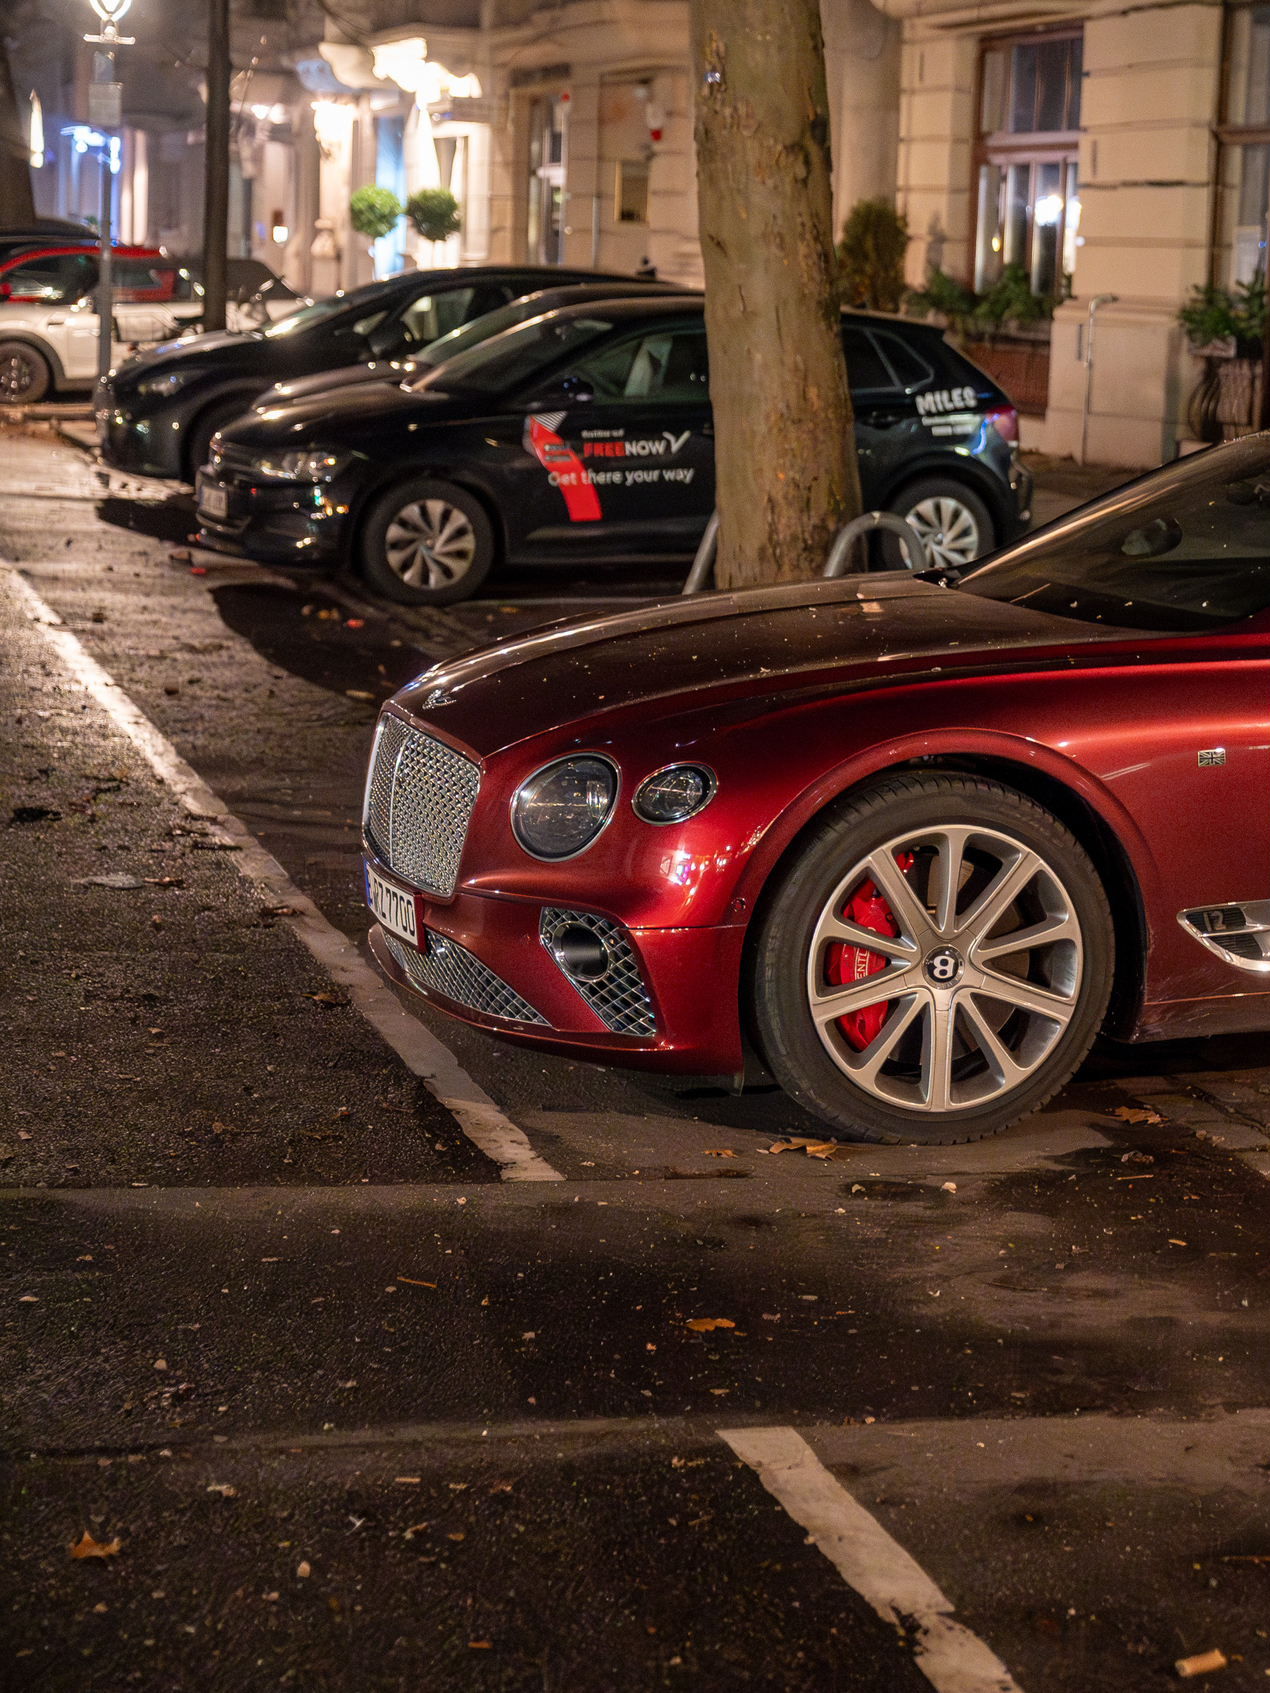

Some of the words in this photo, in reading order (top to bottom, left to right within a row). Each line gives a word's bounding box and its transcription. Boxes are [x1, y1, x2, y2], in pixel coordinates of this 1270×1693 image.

[915, 386, 978, 416] MILES
[548, 470, 577, 487] Get
[581, 468, 623, 485] there
[625, 470, 660, 487] your
[662, 468, 695, 485] way
